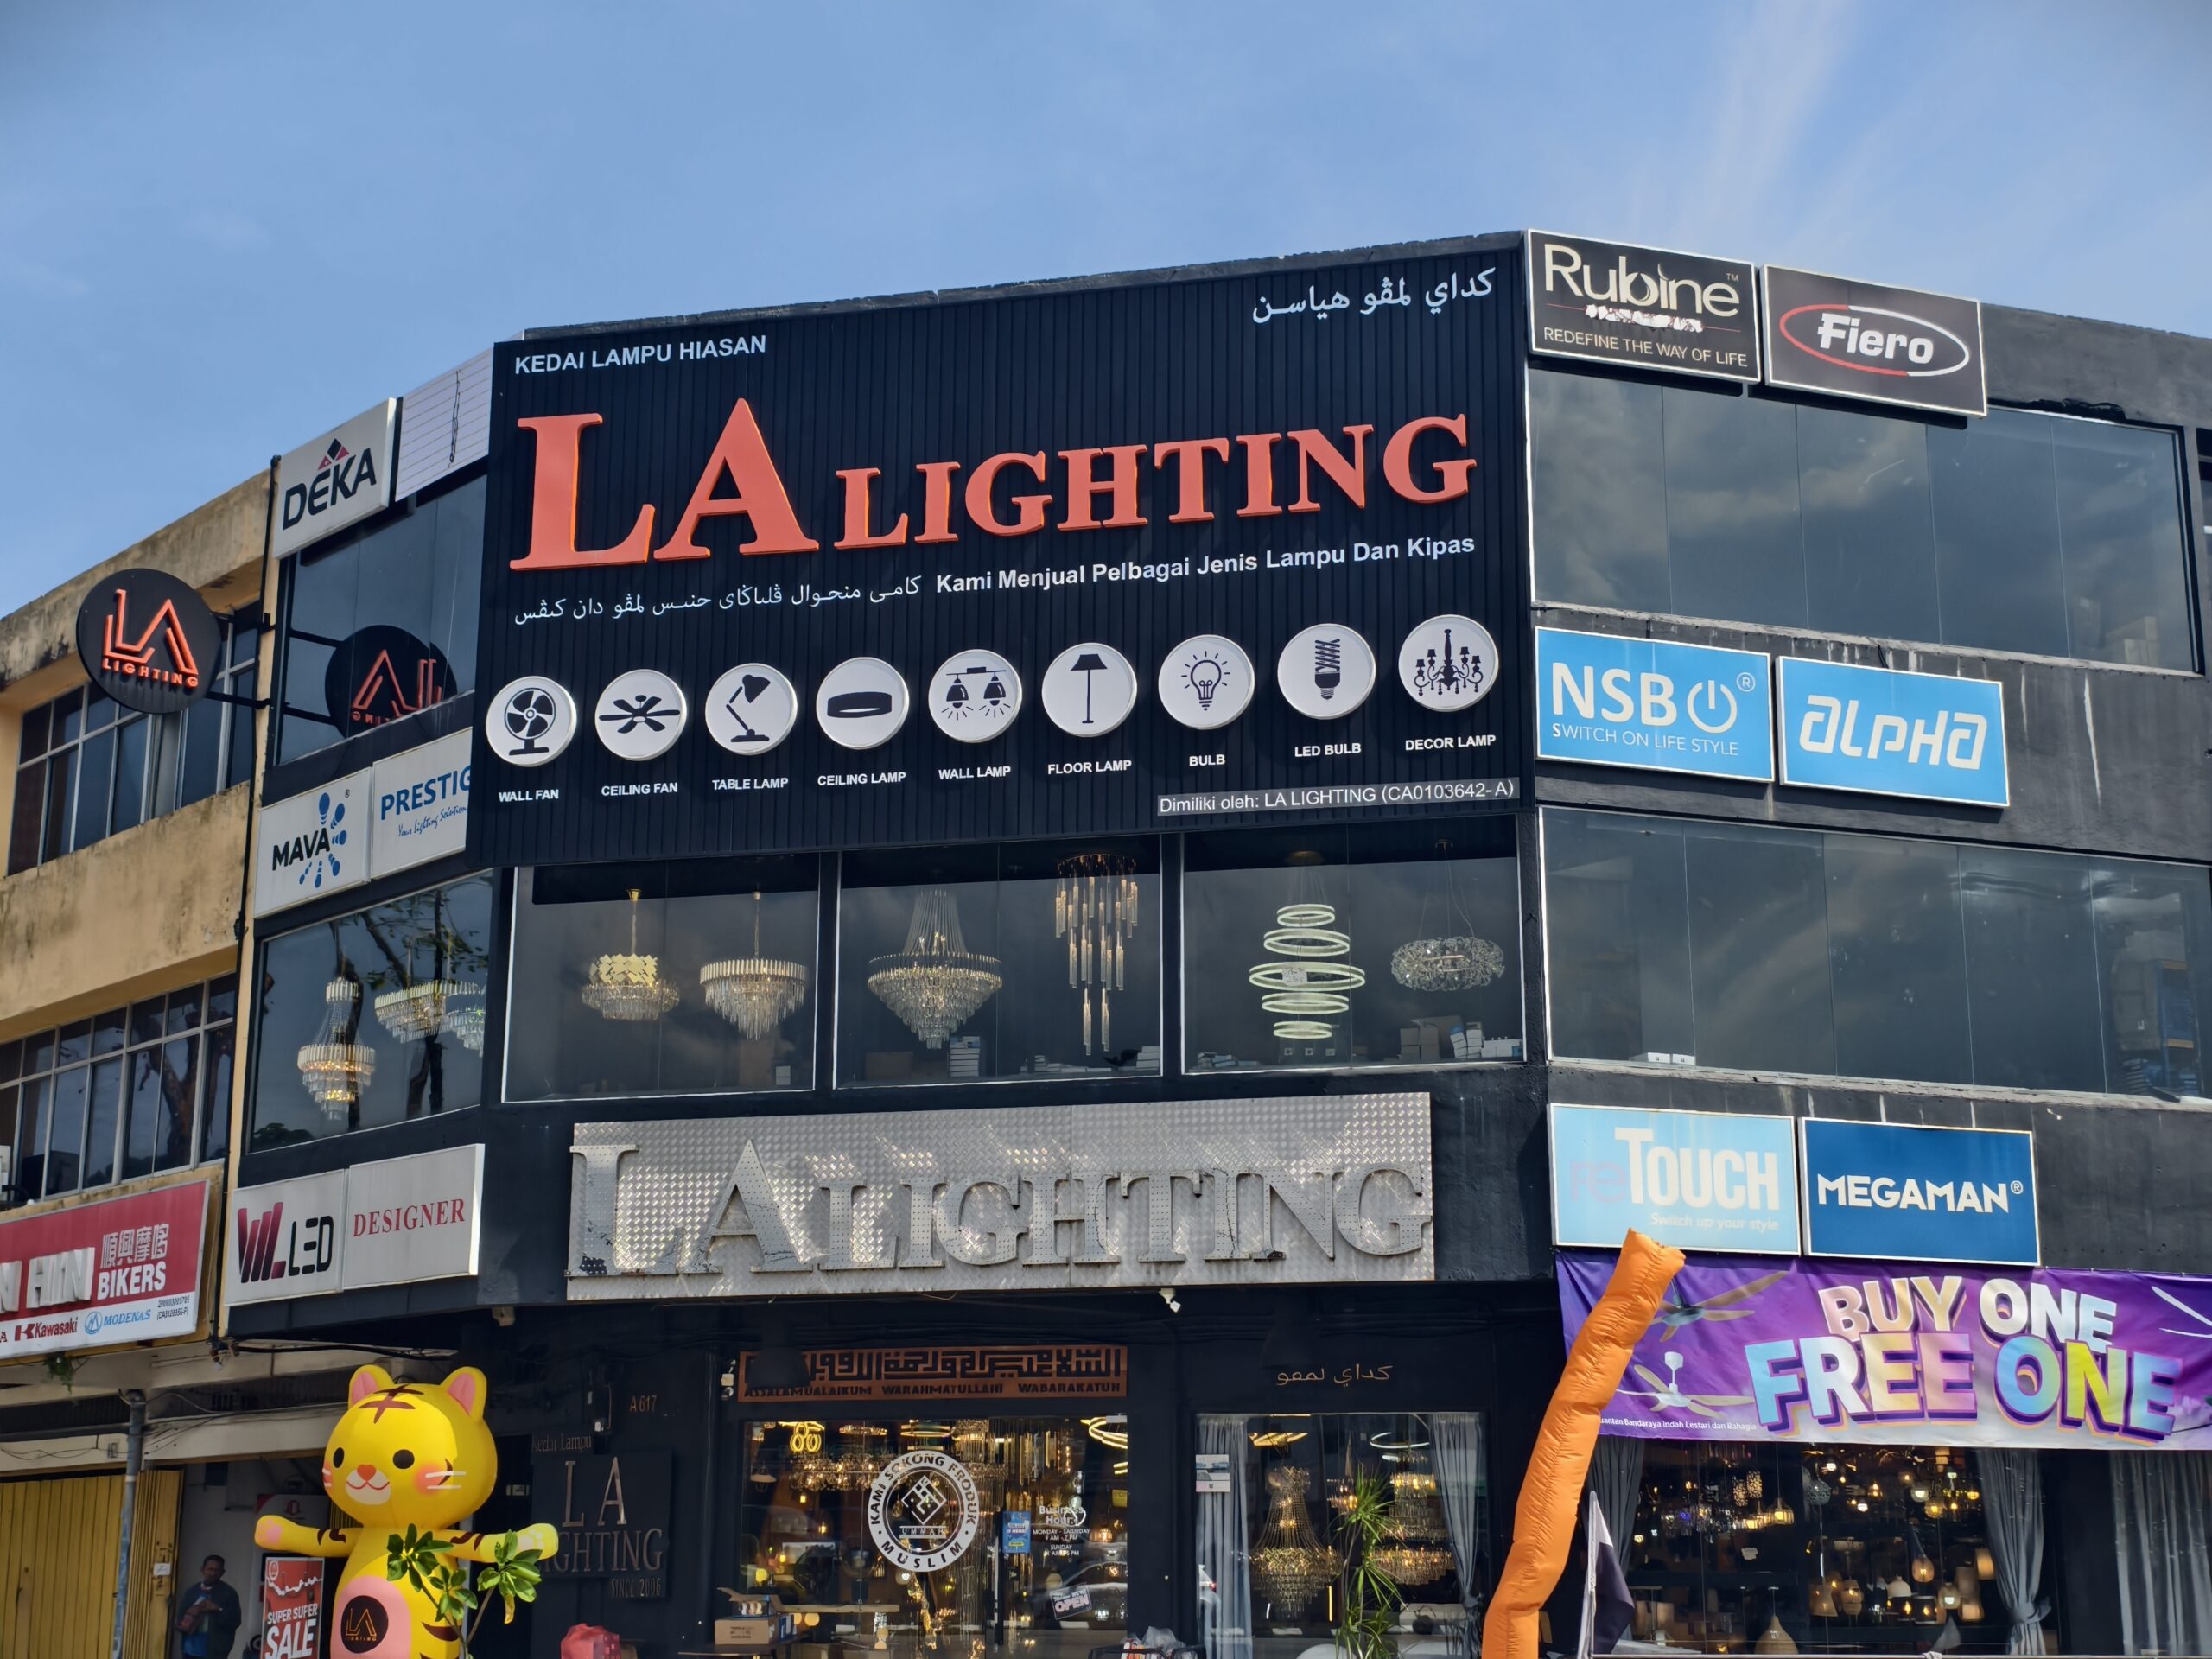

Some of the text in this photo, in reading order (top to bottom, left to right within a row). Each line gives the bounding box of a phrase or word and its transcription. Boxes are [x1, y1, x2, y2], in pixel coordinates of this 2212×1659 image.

[1544, 243, 1740, 317] Rubine
[514, 335, 766, 375] KEDAI LAMPU HIASAN
[1543, 327, 1747, 368] REDEFINE THE WAY OF LIFE
[1817, 312, 1934, 365] Fiero
[283, 448, 377, 531] DEKA
[510, 398, 1477, 571] LA LIGHTING
[936, 534, 1476, 594] Kami Menjual Pelbagai Jenis Lampu Dan Kipas
[104, 588, 199, 674] LA
[101, 658, 199, 688] LIGHTING
[1551, 662, 1678, 728] NSB
[1294, 742, 1362, 757] LED BULB
[1405, 734, 1496, 751] DECOR LAMP
[1552, 722, 1739, 757] SWITCH ON LIFE STYLE
[938, 766, 1011, 780] WALL LAMP
[1047, 759, 1132, 775] FLOOR LAMP
[1189, 753, 1225, 767] BULB
[499, 788, 560, 802] WALL FAN
[601, 782, 678, 798] CEILING FAN
[711, 777, 789, 791] TABLE LAMP
[817, 771, 906, 787] CEILING LAMP
[1159, 796, 1217, 814] Dimiliki
[1221, 793, 1260, 810] oleh:
[1264, 792, 1287, 808] LA
[1291, 787, 1376, 806] LIGHTING
[272, 827, 331, 871] MAVA
[353, 1198, 466, 1237] DESIGNER
[563, 1137, 1433, 1277] LA LIGHTING
[1649, 1212, 1780, 1232] Switch up your style
[97, 1261, 167, 1300] BIKERS
[35, 1316, 79, 1338] Kawasaki
[103, 1309, 151, 1326] MODENAS
[1818, 1275, 2117, 1353] BUY ONE
[1744, 1332, 2183, 1436] FREE ONE
[1624, 1418, 1662, 1429] Bandaraya
[1727, 1422, 1757, 1431] Bahagia
[870, 1483, 887, 1525] KAMI
[884, 1453, 945, 1481] SOKONG
[541, 1528, 664, 1573] GHTING
[881, 1541, 963, 1569] MUSLIM
[267, 1609, 292, 1625] SUPER
[1054, 1594, 1090, 1613] OPEN
[264, 1618, 317, 1659] SALE
